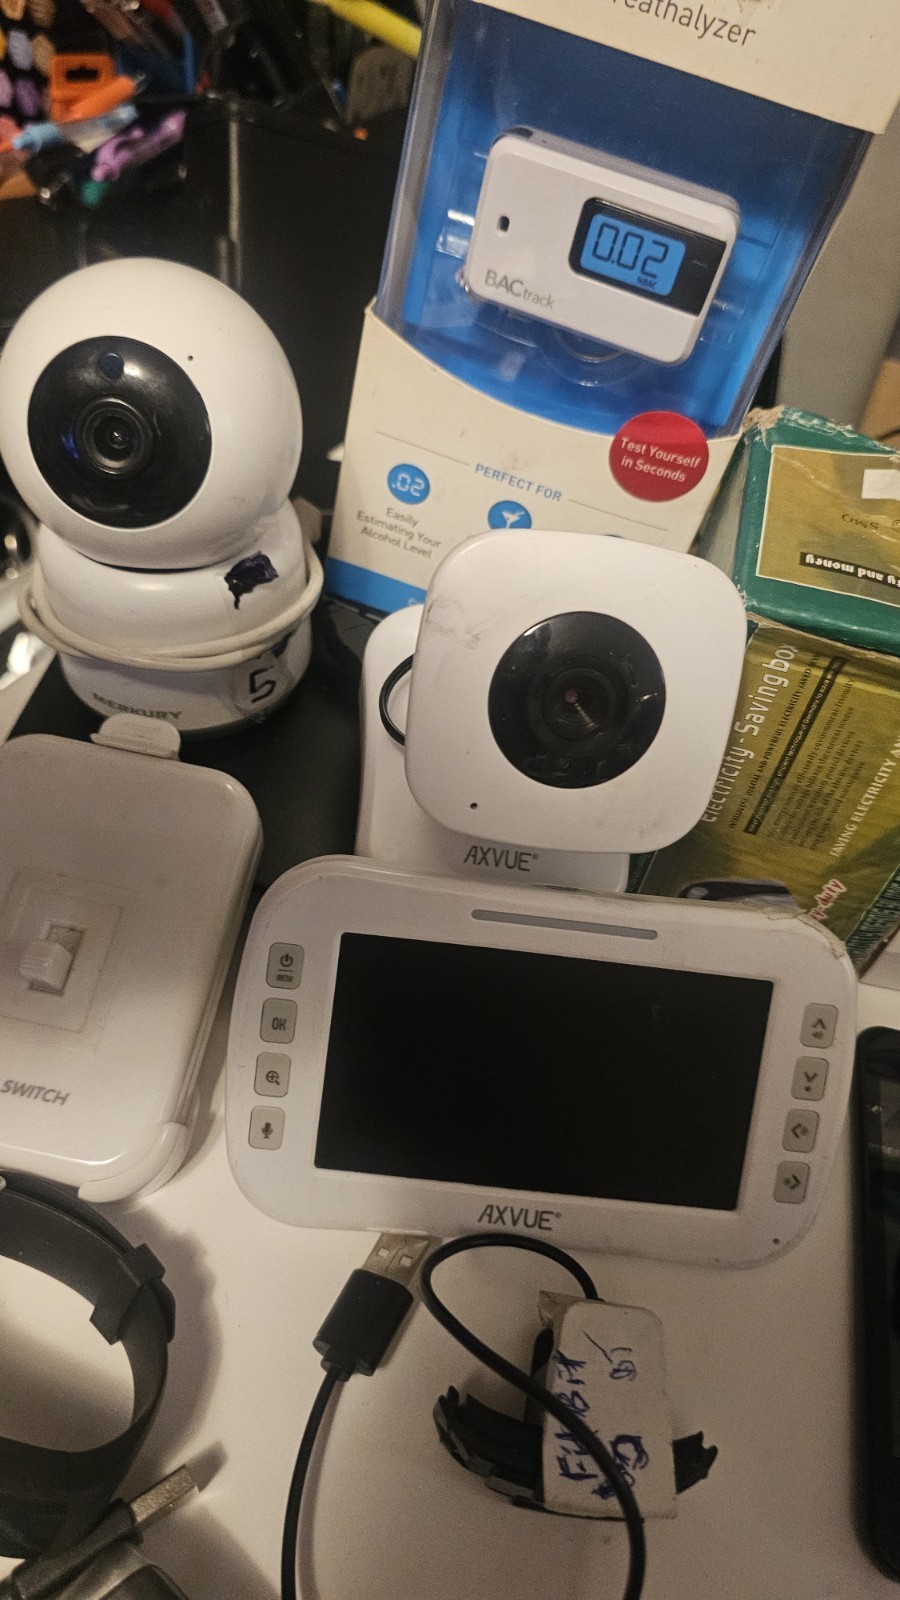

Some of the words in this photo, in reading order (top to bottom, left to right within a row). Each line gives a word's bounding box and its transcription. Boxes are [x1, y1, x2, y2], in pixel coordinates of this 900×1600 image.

[613, 0, 756, 46] athalyzer
[592, 222, 669, 279] 0.02
[484, 269, 555, 310] BACtrack
[620, 437, 647, 455] Test
[650, 445, 701, 469] Yourself
[392, 473, 425, 497] .02
[474, 463, 533, 492] PERFECT
[535, 484, 562, 502] FOR
[621, 456, 634, 469] in
[635, 459, 686, 483] Seconds
[357, 510, 415, 540] Estimating
[418, 532, 443, 548] Your
[386, 507, 419, 528] Easily
[361, 526, 401, 548] Alcohol
[403, 541, 432, 559] Level
[805, 553, 855, 573] money
[857, 567, 883, 581] and
[761, 643, 799, 673] box
[249, 665, 276, 704] 5
[849, 758, 897, 822] ELECTRICITY
[272, 1017, 287, 1031] OK
[1, 1079, 71, 1106] SWITCH
